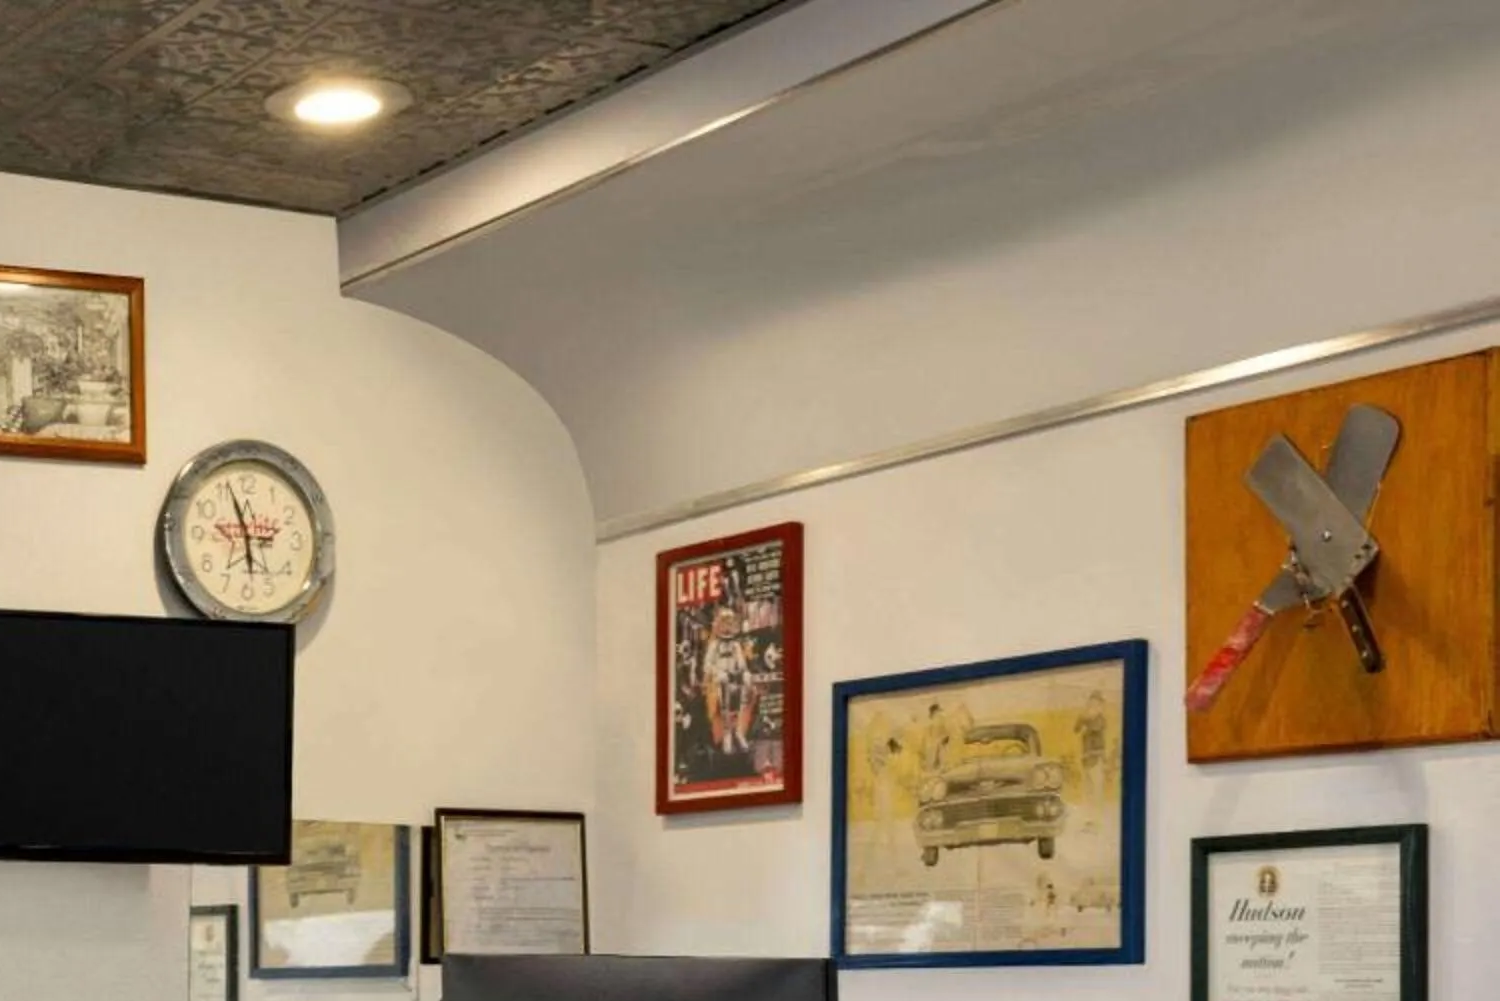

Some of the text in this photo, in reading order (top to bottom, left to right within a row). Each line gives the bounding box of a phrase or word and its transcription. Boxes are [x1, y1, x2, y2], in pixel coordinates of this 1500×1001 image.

[239, 474, 257, 494] 12
[196, 499, 216, 520] 10
[283, 505, 295, 525] 2
[191, 524, 205, 543] 9
[290, 530, 302, 550] 3
[280, 560, 292, 575] 4
[220, 573, 231, 593] 7
[241, 582, 255, 601] 6
[678, 564, 722, 603] LIFE
[1229, 898, 1306, 922] Hudson
